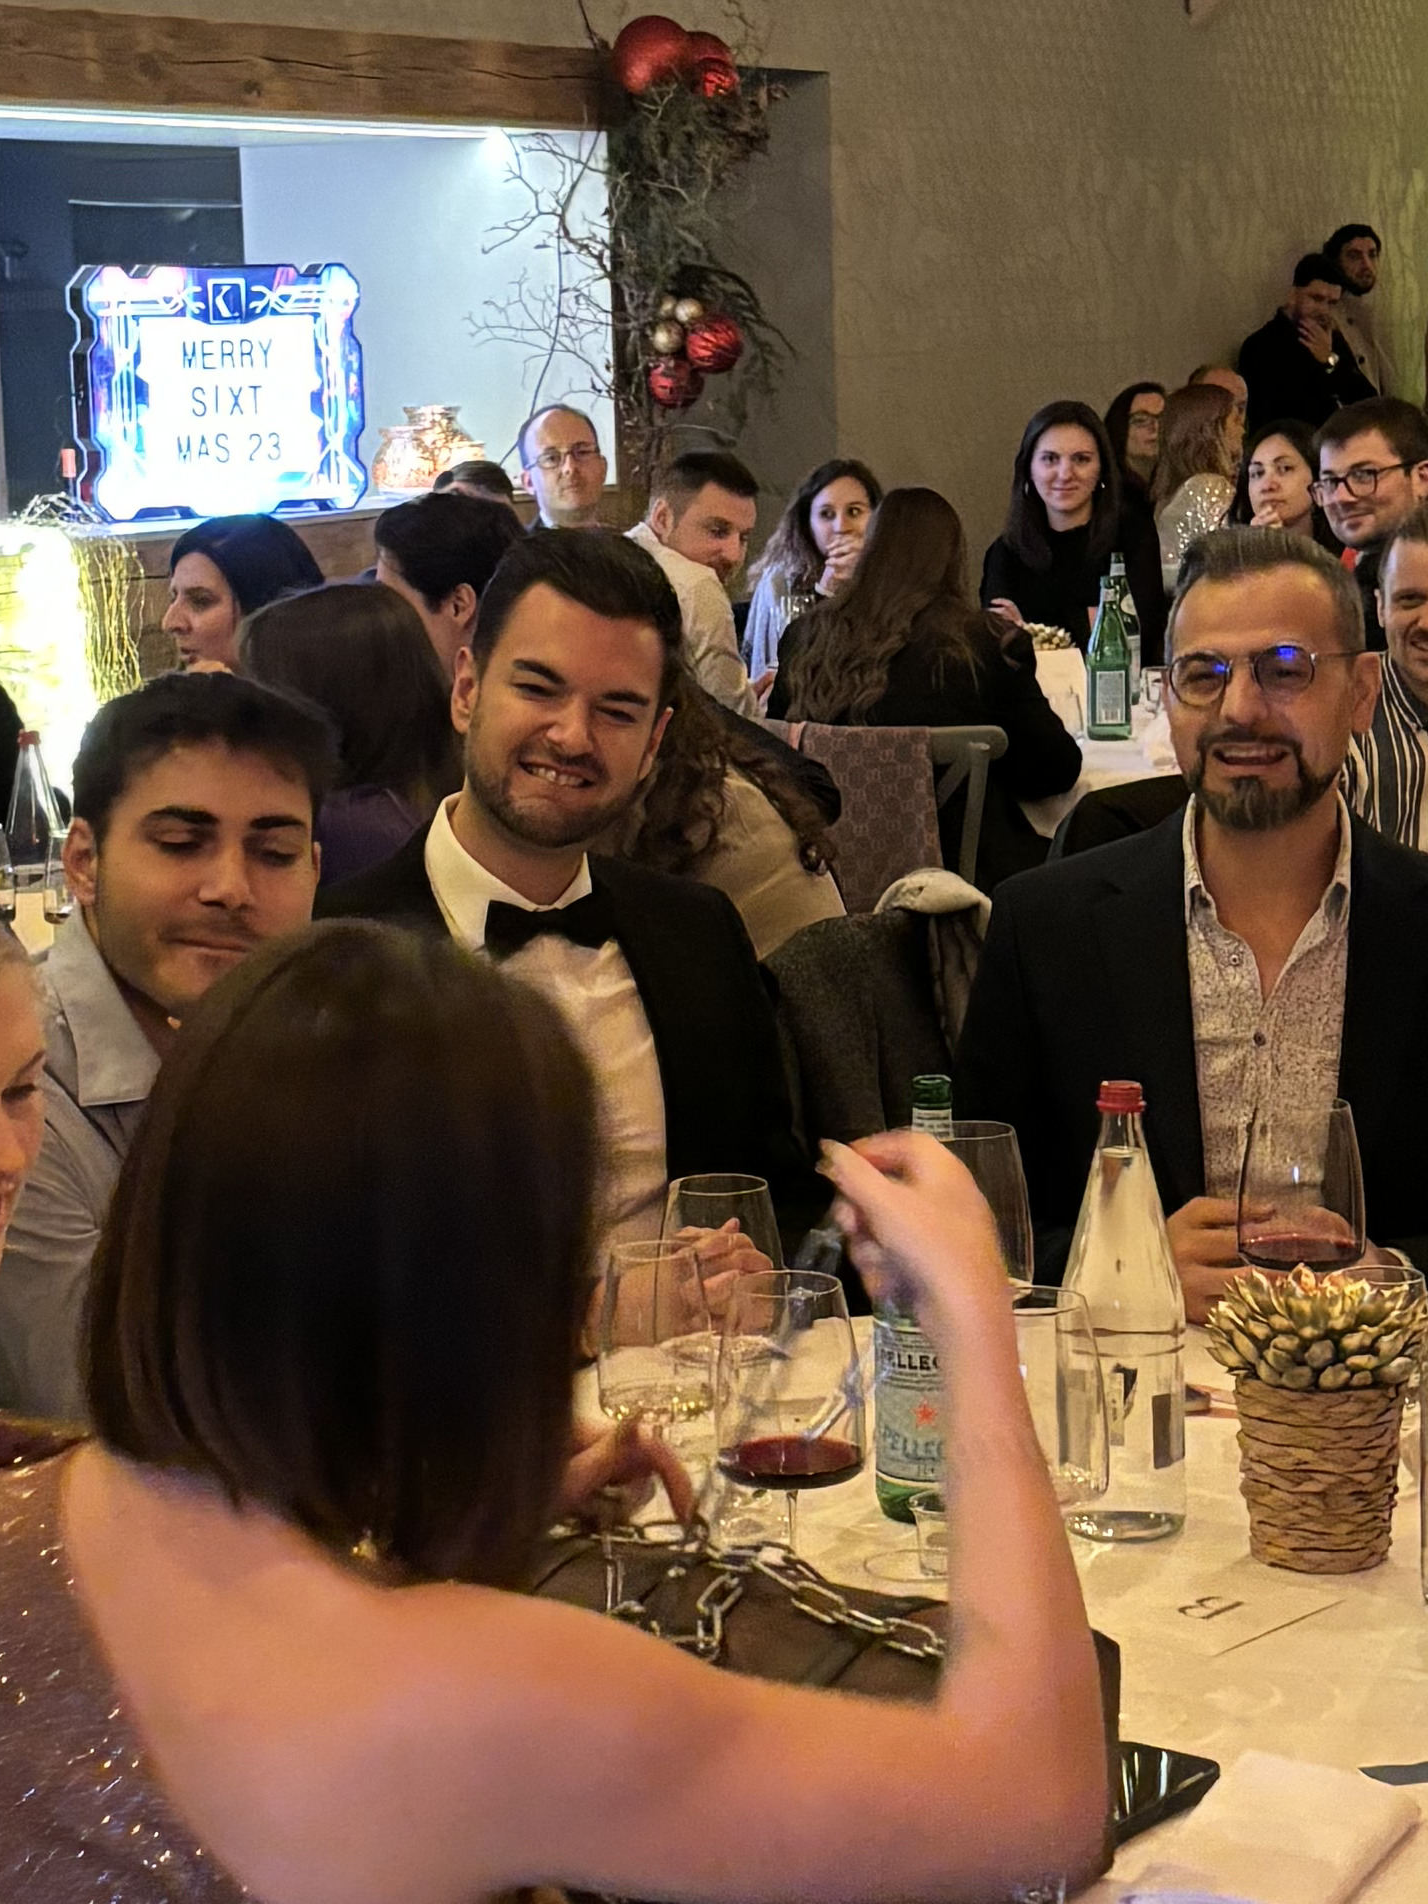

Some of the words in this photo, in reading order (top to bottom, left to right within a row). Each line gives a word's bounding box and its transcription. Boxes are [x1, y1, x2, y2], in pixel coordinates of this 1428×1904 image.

[181, 339, 273, 370] MERRY
[191, 385, 263, 417] SIXT
[176, 433, 231, 463] MAS
[248, 432, 282, 462] 23
